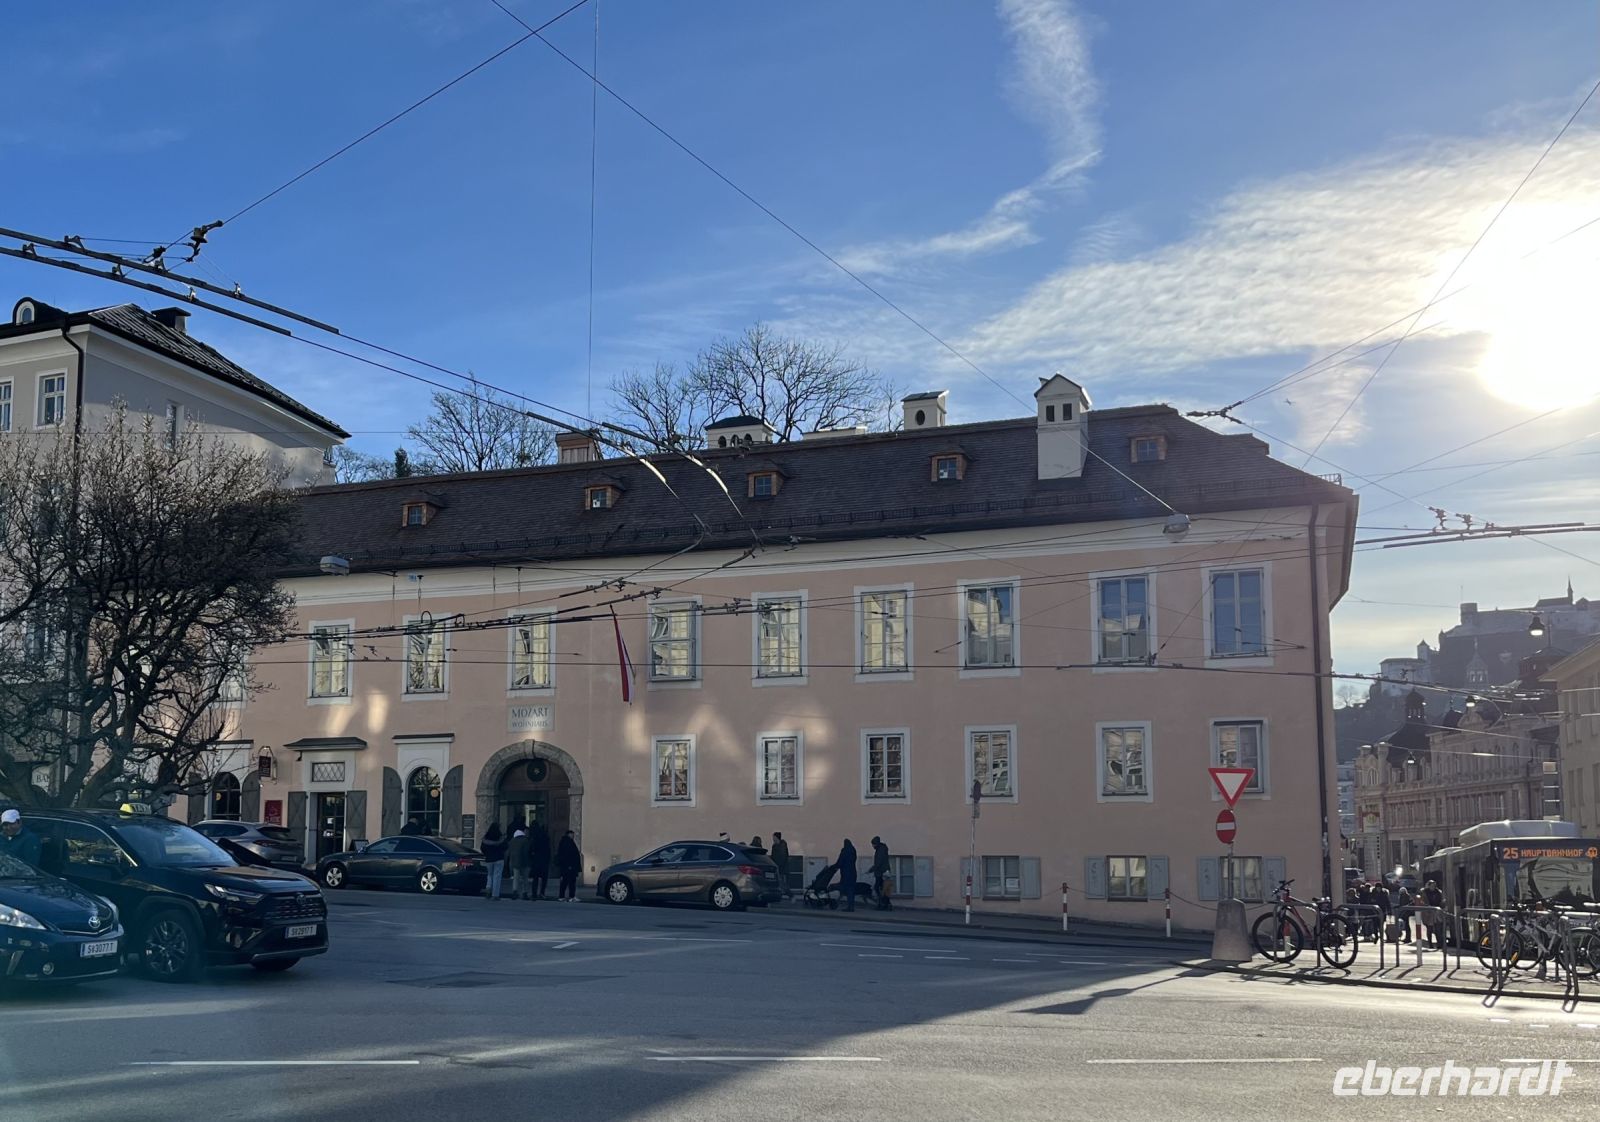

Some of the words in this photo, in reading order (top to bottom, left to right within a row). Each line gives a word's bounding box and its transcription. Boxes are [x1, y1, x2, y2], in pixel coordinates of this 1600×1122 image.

[511, 707, 548, 718] MOZART
[1503, 847, 1518, 859] 25
[1521, 848, 1584, 857] HAUPTBAHNHOF
